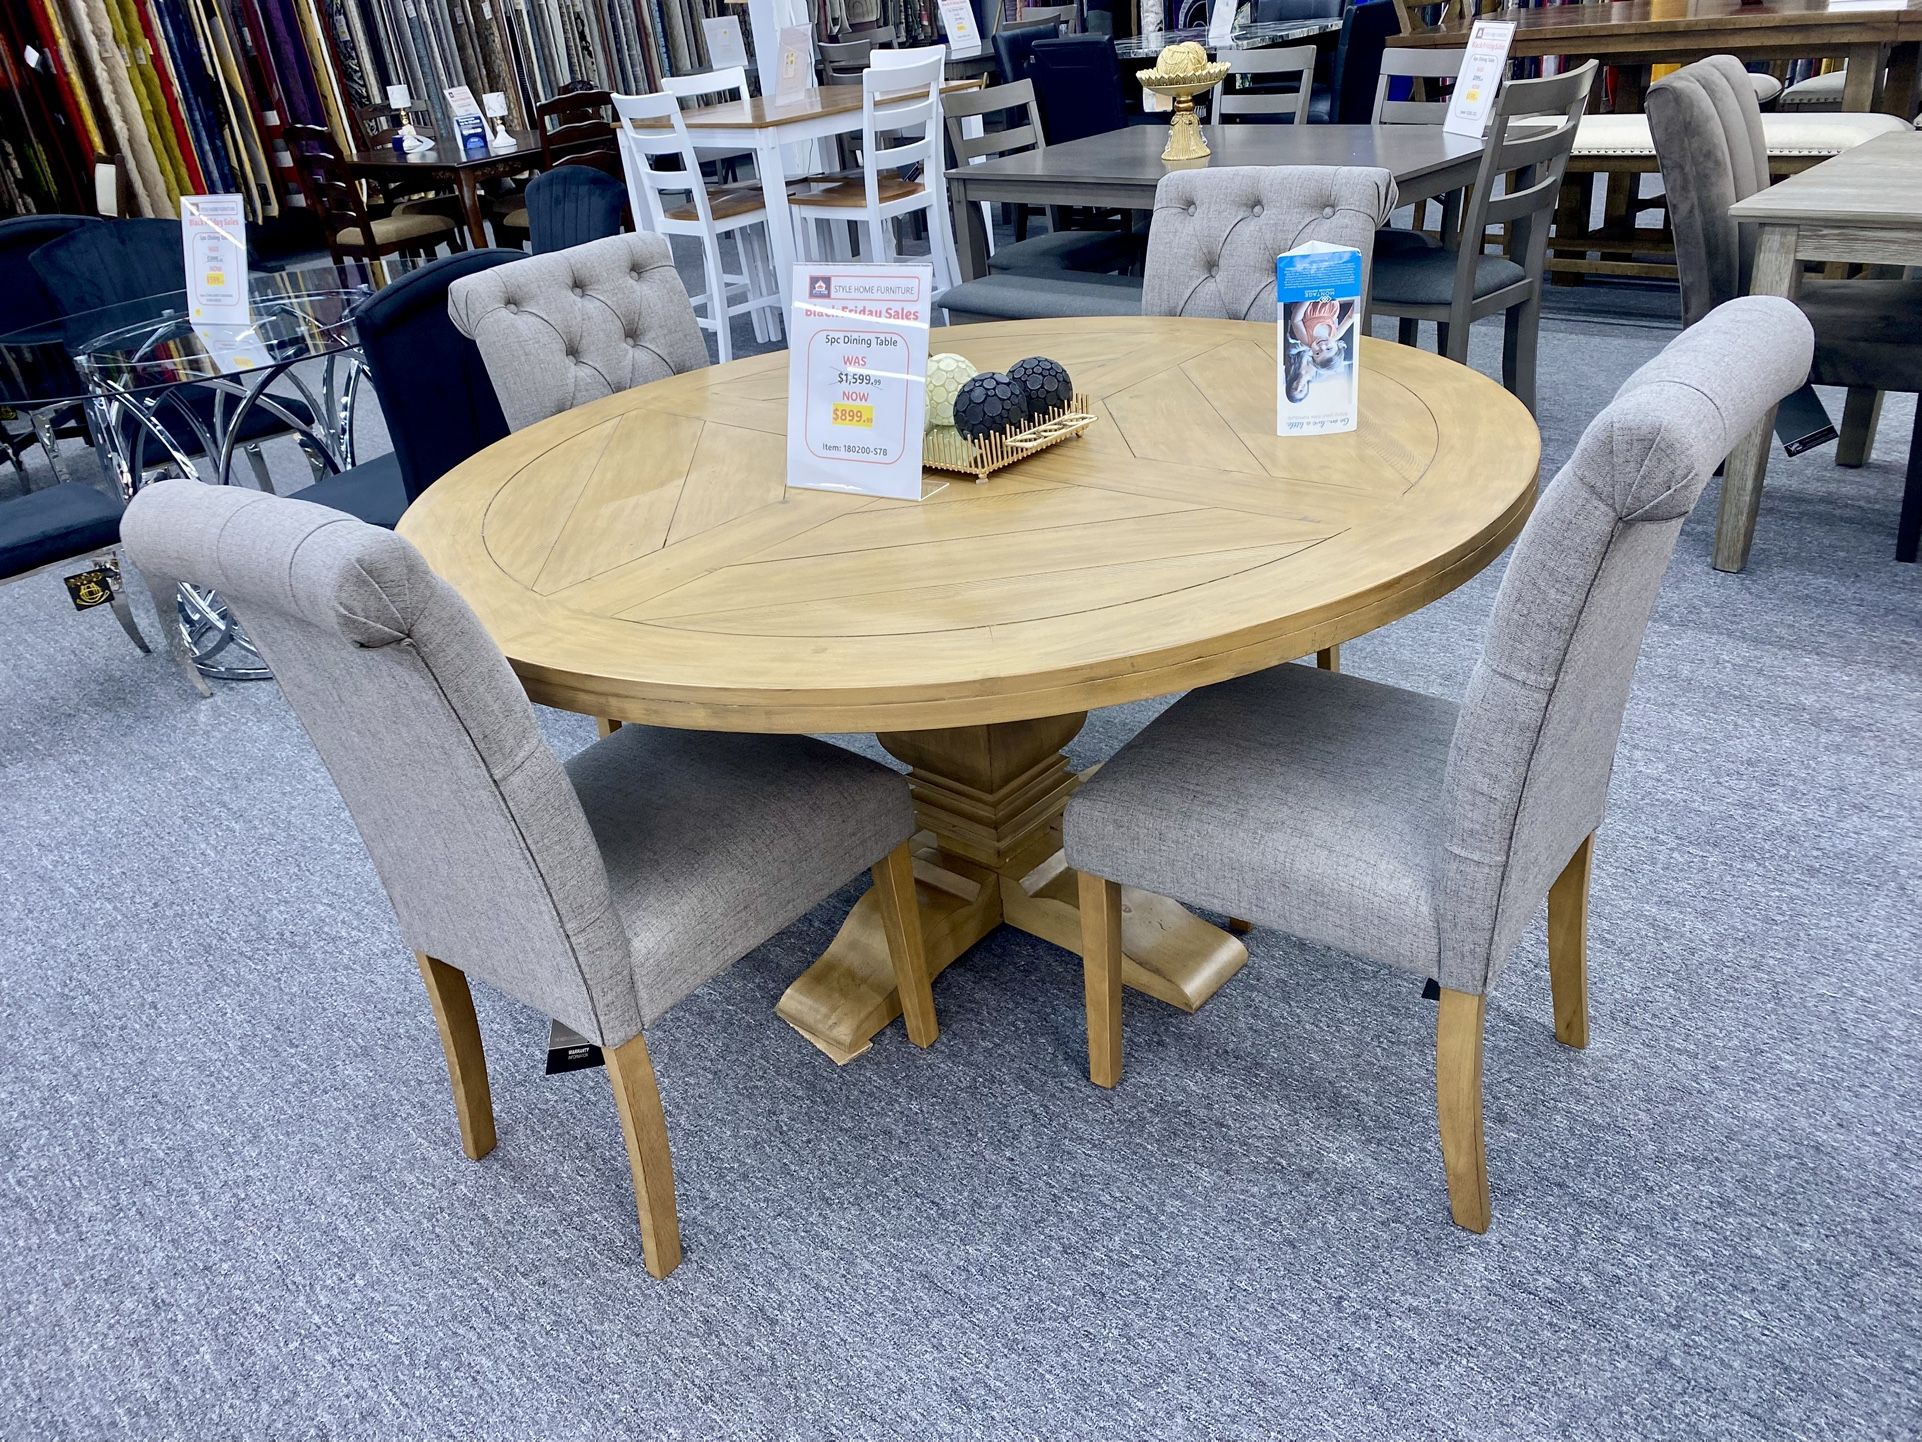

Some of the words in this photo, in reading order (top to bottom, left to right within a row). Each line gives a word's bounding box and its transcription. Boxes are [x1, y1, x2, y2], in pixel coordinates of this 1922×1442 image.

[834, 284, 852, 294] STYLE
[854, 285, 875, 295] HOME
[876, 285, 914, 296] FURNITURE
[1304, 290, 1335, 298] MONTAGE
[884, 306, 920, 321] Sales
[825, 334, 841, 346] 5pc
[843, 334, 872, 349] Dining
[874, 335, 898, 347] Table
[843, 355, 867, 367] WAS
[838, 372, 882, 386] $1,599.99
[842, 390, 869, 402] NOW
[1340, 417, 1350, 427] Go
[822, 442, 842, 452] Item:
